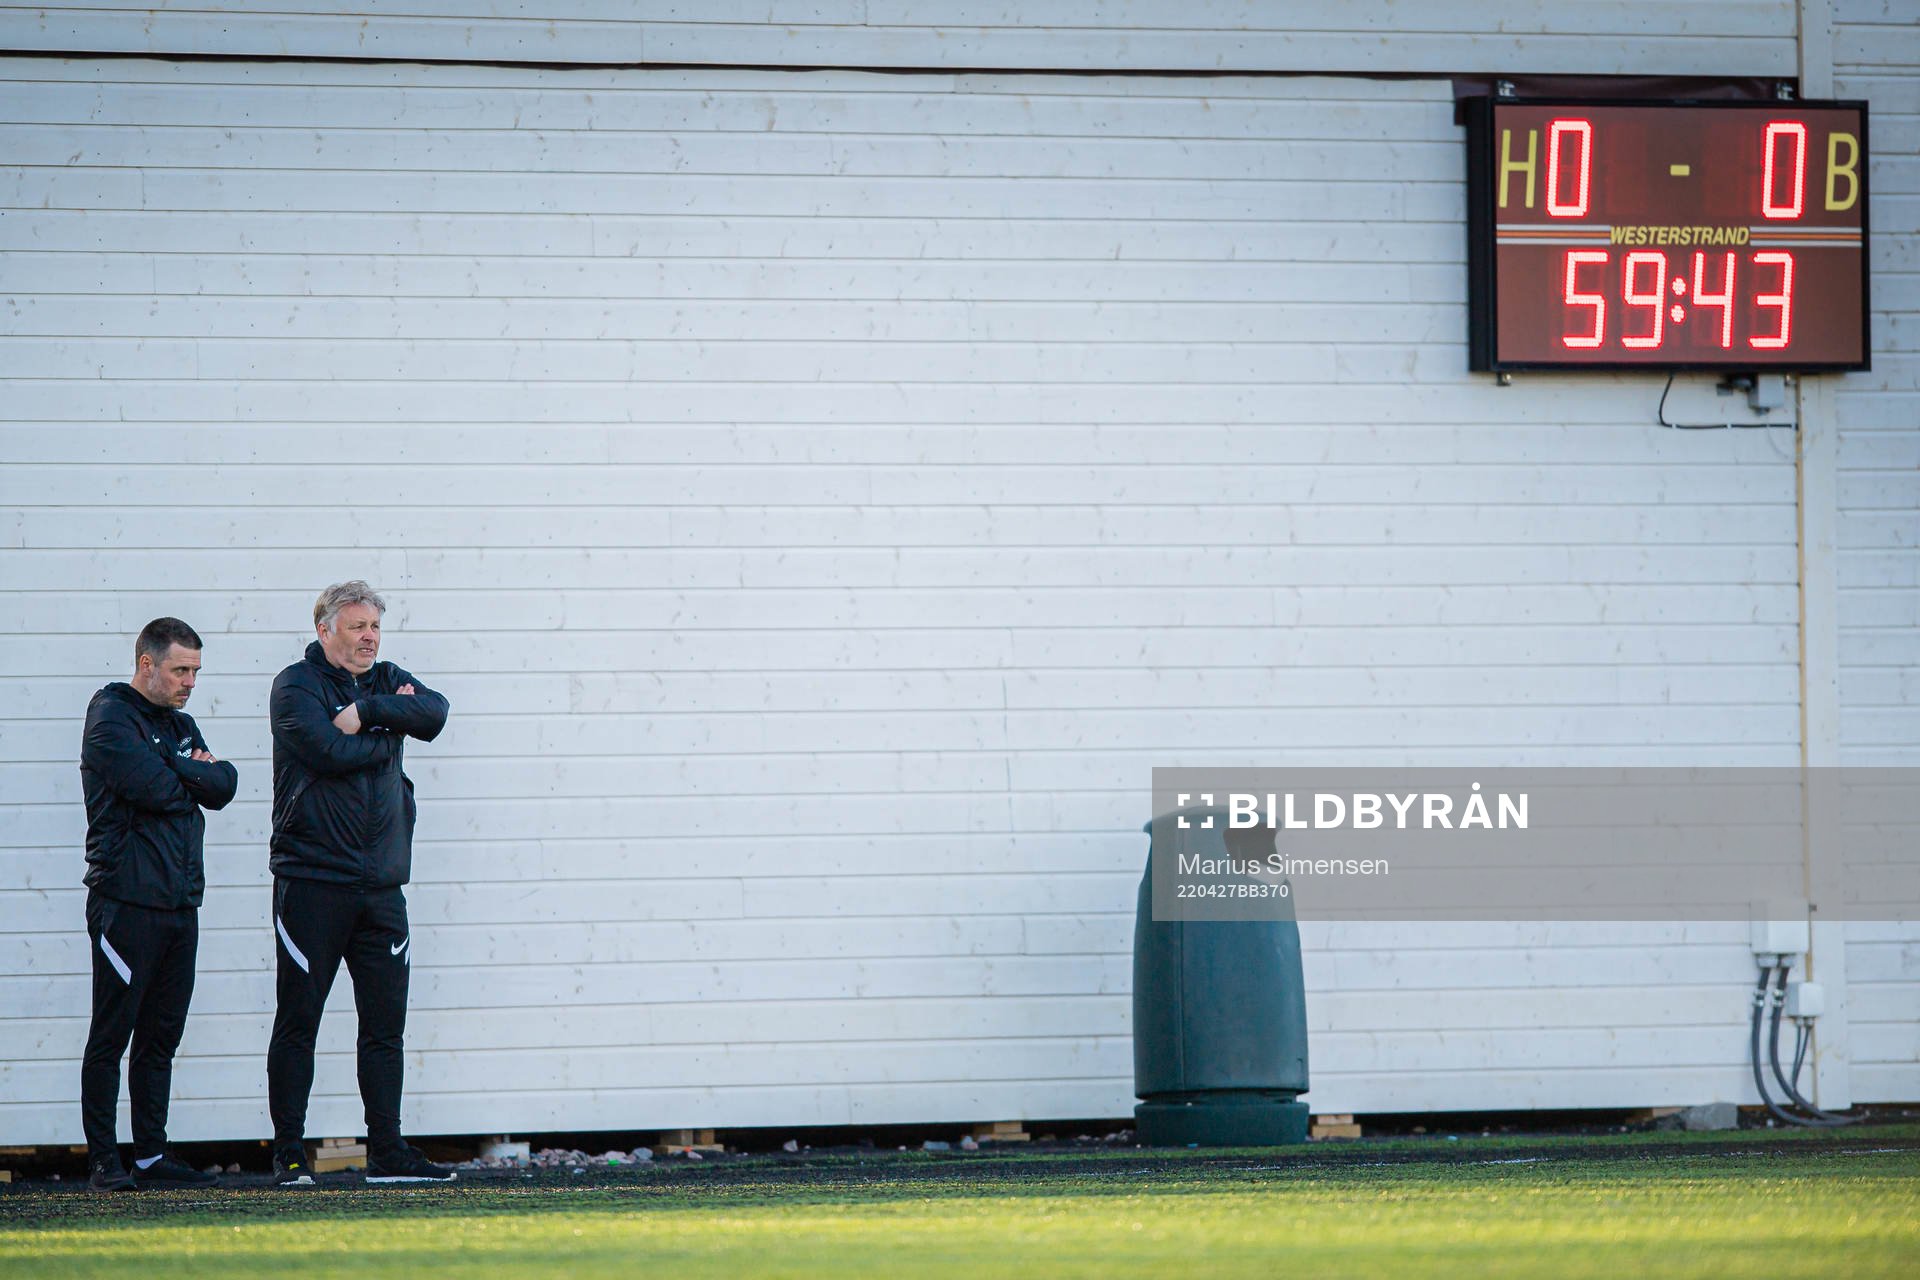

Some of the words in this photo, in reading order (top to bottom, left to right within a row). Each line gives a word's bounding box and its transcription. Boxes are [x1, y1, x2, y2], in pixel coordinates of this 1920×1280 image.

[1499, 129, 1537, 208] H
[1546, 118, 1592, 217] 0
[1762, 121, 1806, 219] 0
[1825, 132, 1859, 211] B
[1610, 226, 1750, 246] WESTERSTRAND
[1563, 250, 1794, 348] 59:43
